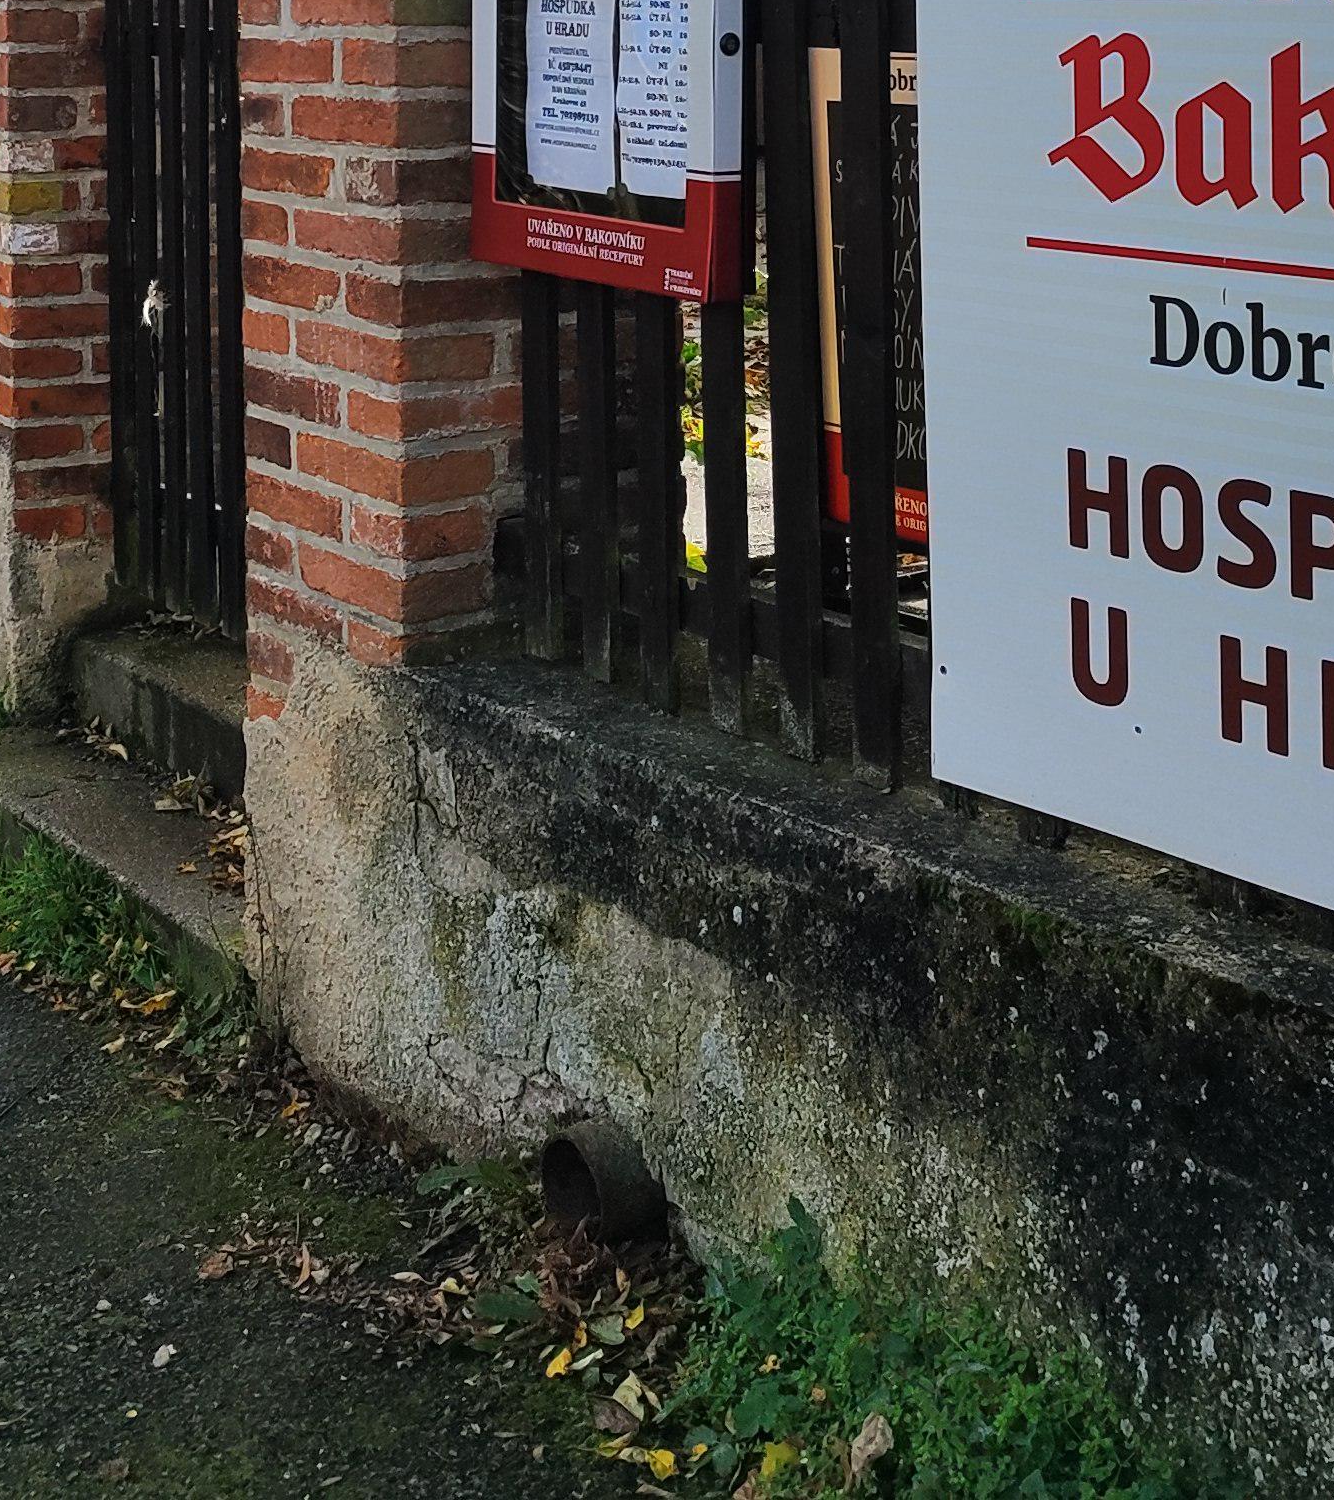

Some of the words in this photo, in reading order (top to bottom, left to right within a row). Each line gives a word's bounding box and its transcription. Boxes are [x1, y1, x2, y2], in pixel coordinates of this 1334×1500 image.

[546, 21, 553, 36] U
[554, 21, 591, 38] HRADU
[527, 218, 574, 239] UVAŘENO
[574, 225, 583, 241] V
[584, 227, 646, 251] RAKOVNÍKU
[526, 236, 551, 251] PODLE
[551, 240, 598, 260] ORIGINÁLNÍ
[598, 248, 645, 267] RECEPTURY
[1070, 597, 1129, 708] U
